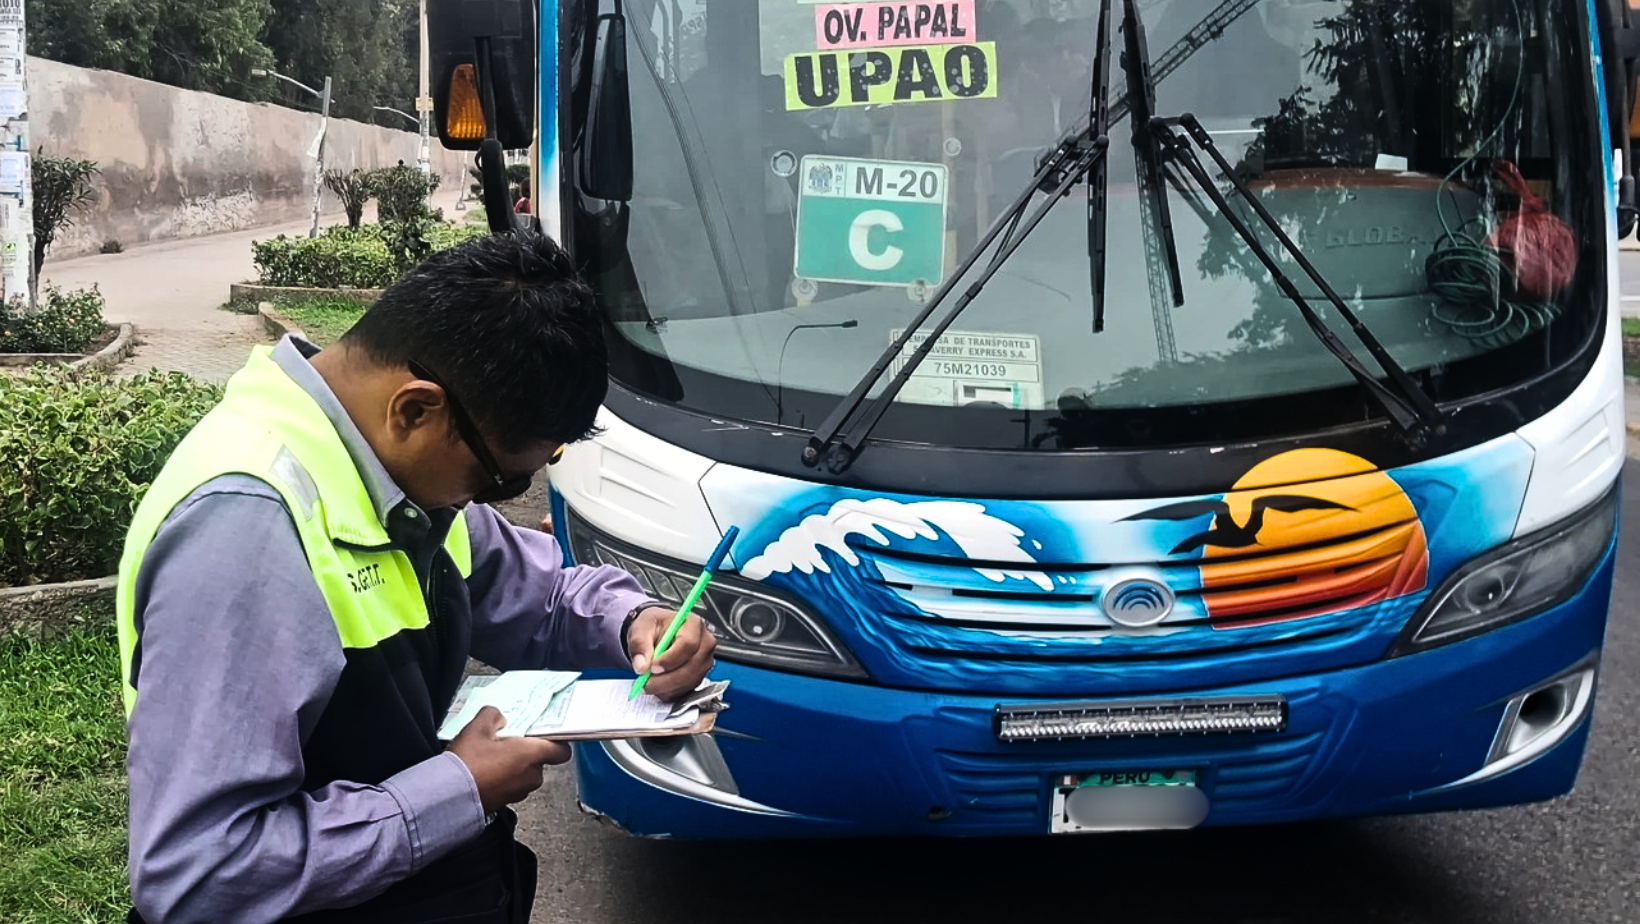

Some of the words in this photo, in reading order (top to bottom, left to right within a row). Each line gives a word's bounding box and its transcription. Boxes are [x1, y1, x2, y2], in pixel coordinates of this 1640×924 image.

[824, 8, 867, 44] OV.
[878, 4, 966, 40] PAPAL
[794, 45, 988, 107] UPAO
[855, 166, 938, 198] M-20
[848, 209, 903, 270] C
[909, 334, 949, 344] EMPSA
[954, 336, 965, 345] DE
[967, 337, 1031, 349] TRANSPORTES
[912, 344, 963, 355] SAVERRY
[969, 347, 1008, 358] EXPRESS
[934, 361, 1007, 377] 75M21039
[1099, 772, 1150, 785] PERU
